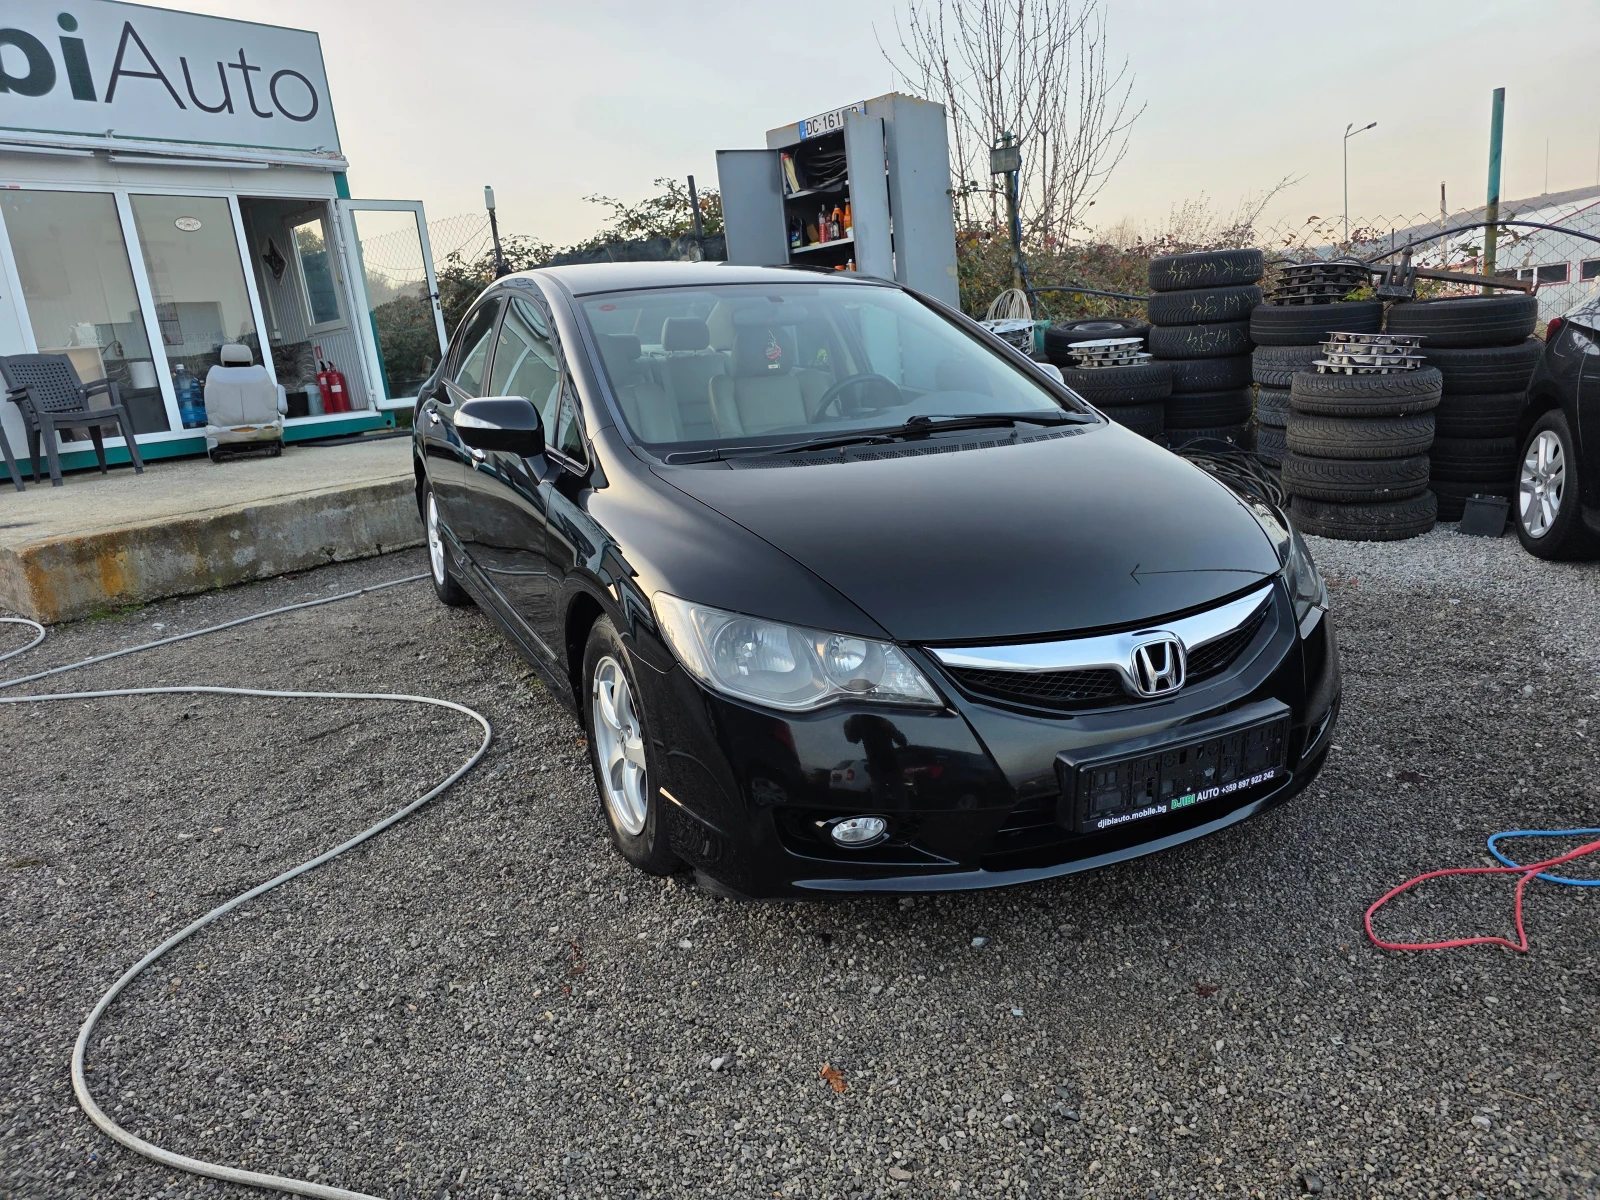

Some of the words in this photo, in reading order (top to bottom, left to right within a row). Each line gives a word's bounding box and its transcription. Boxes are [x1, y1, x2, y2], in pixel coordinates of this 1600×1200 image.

[1097, 804, 1167, 828] djibiauto.mobile.bg
[1171, 793, 1196, 809] DJIBI
[1196, 787, 1220, 802] AUTO
[1221, 782, 1237, 794] +359
[1238, 778, 1250, 789] 897
[1250, 774, 1262, 785] 922
